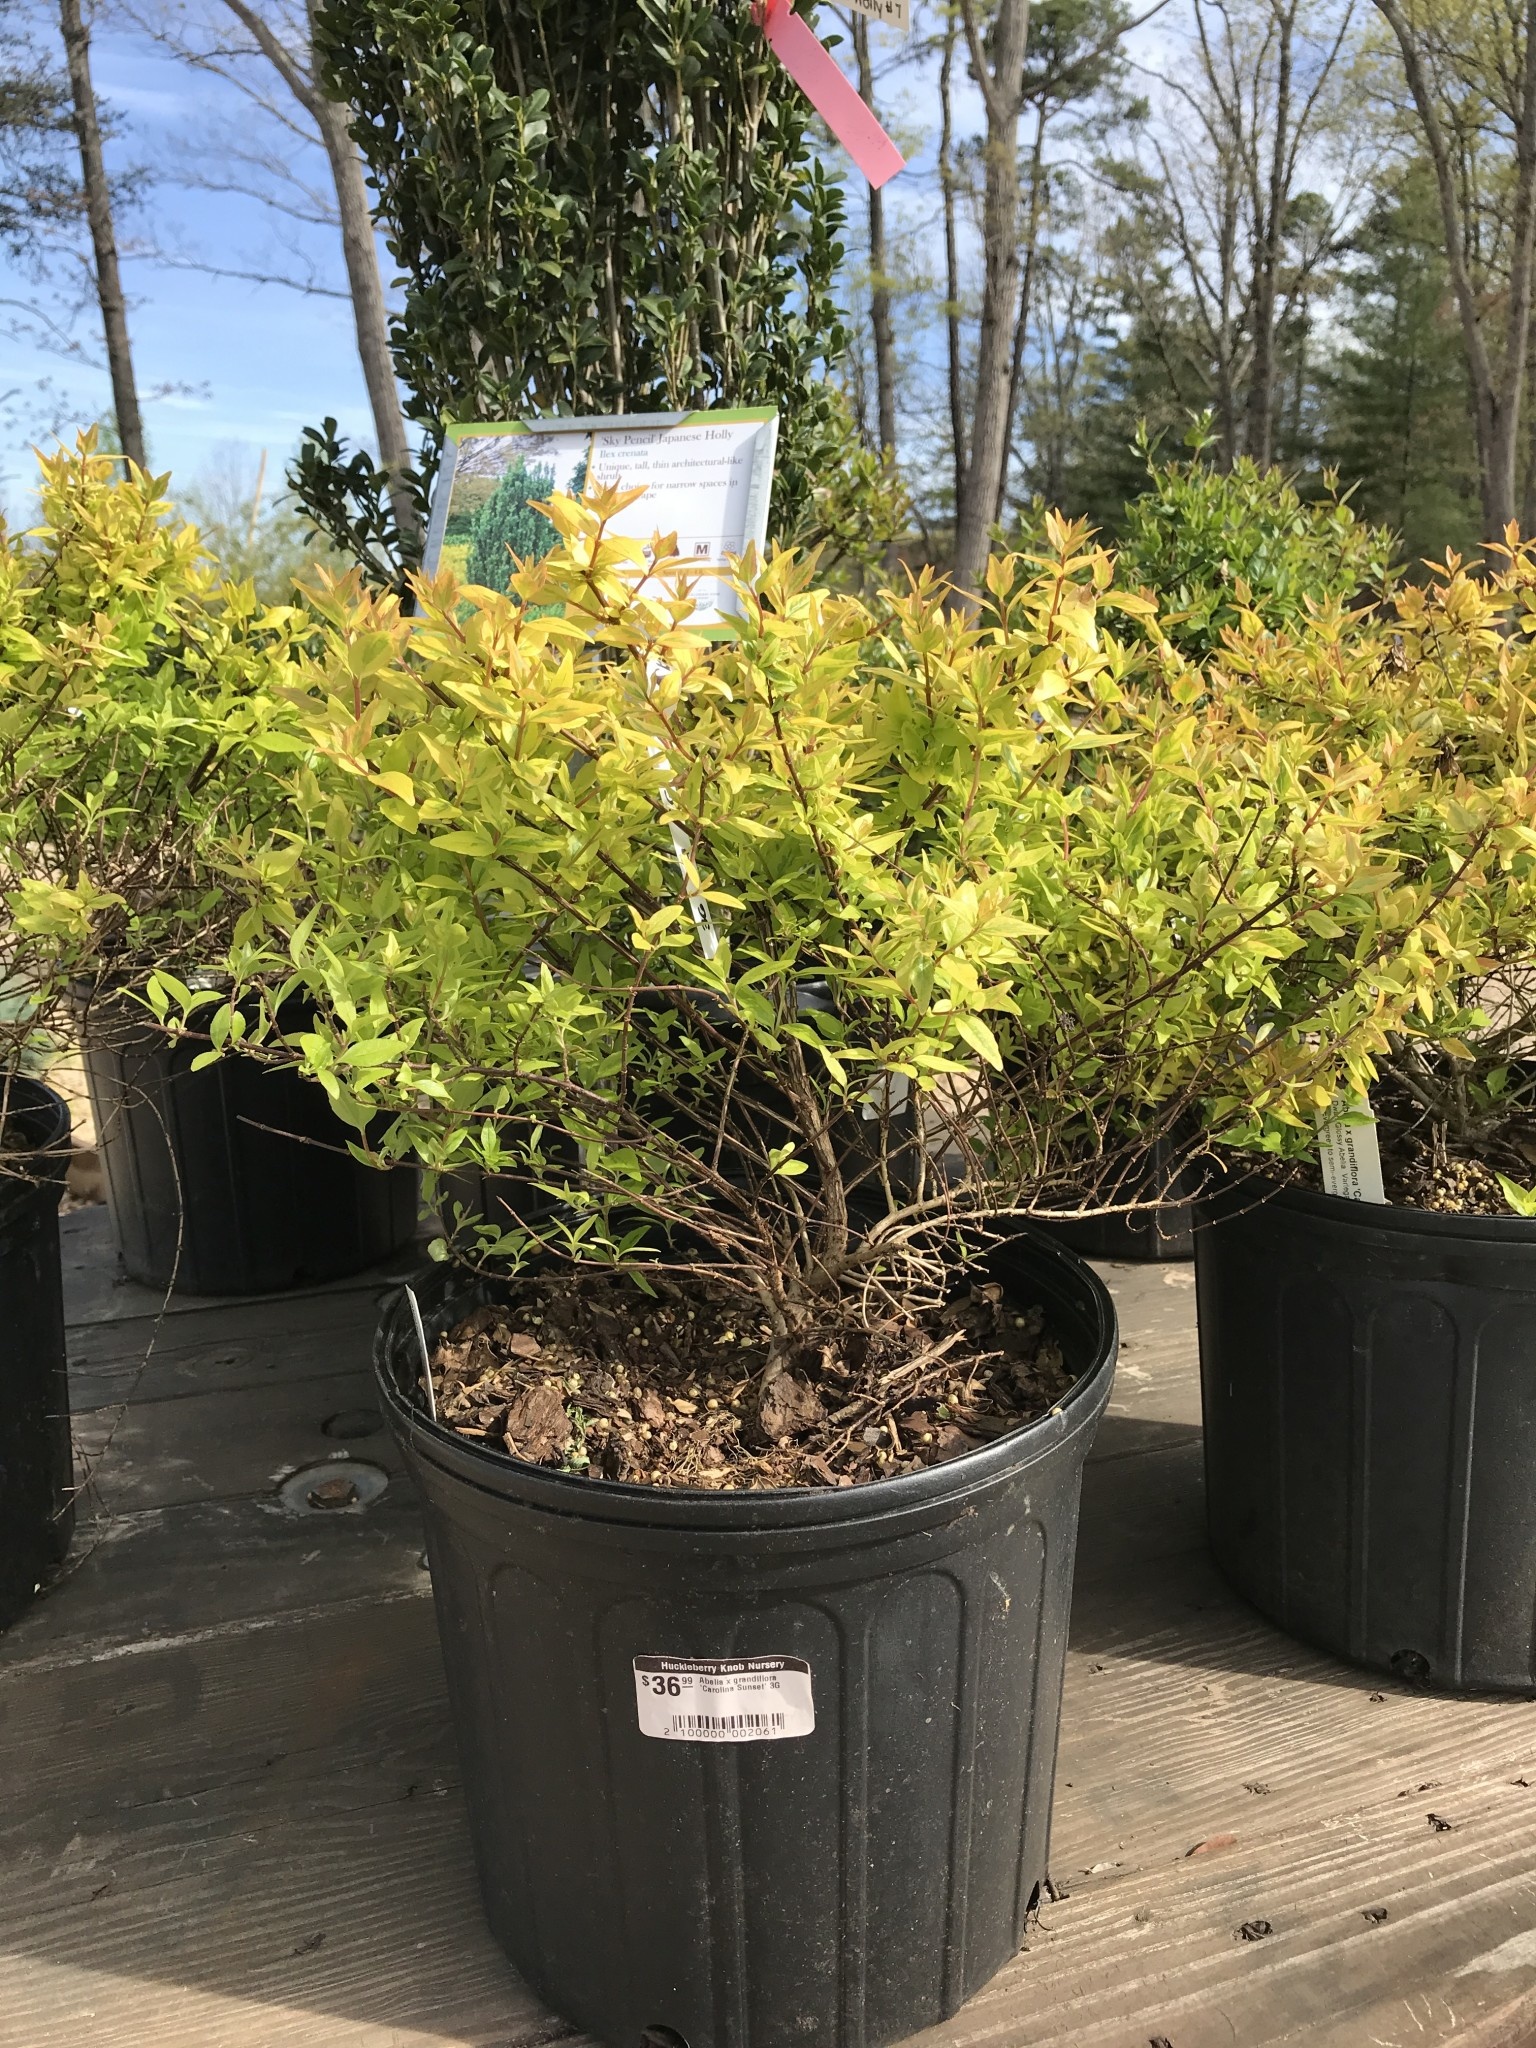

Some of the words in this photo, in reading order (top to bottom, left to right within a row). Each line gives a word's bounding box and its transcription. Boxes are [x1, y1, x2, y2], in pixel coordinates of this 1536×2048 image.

[656, 432, 702, 445] Japanese
[705, 429, 733, 440] Holly
[600, 450, 615, 458] Ilex
[617, 450, 648, 458] crenata
[598, 462, 632, 472] Unique,
[635, 461, 650, 470] tall,
[652, 460, 669, 469] thin
[671, 456, 744, 468] architectural-like
[650, 481, 664, 489] for
[666, 481, 697, 489] narrow
[699, 479, 727, 489] spaces
[696, 545, 708, 554] M
[1334, 1122, 1343, 1146] Glossy
[1327, 1148, 1333, 1156] to
[1338, 1147, 1347, 1169] Abelia
[1344, 1137, 1358, 1186] grandiflora
[661, 1661, 717, 1673] Huckleberry
[720, 1663, 745, 1672] Knob
[748, 1660, 785, 1671] Nursery
[699, 1676, 723, 1686] Abelia
[733, 1674, 777, 1685] grandiflora
[770, 1681, 780, 1689] 3G
